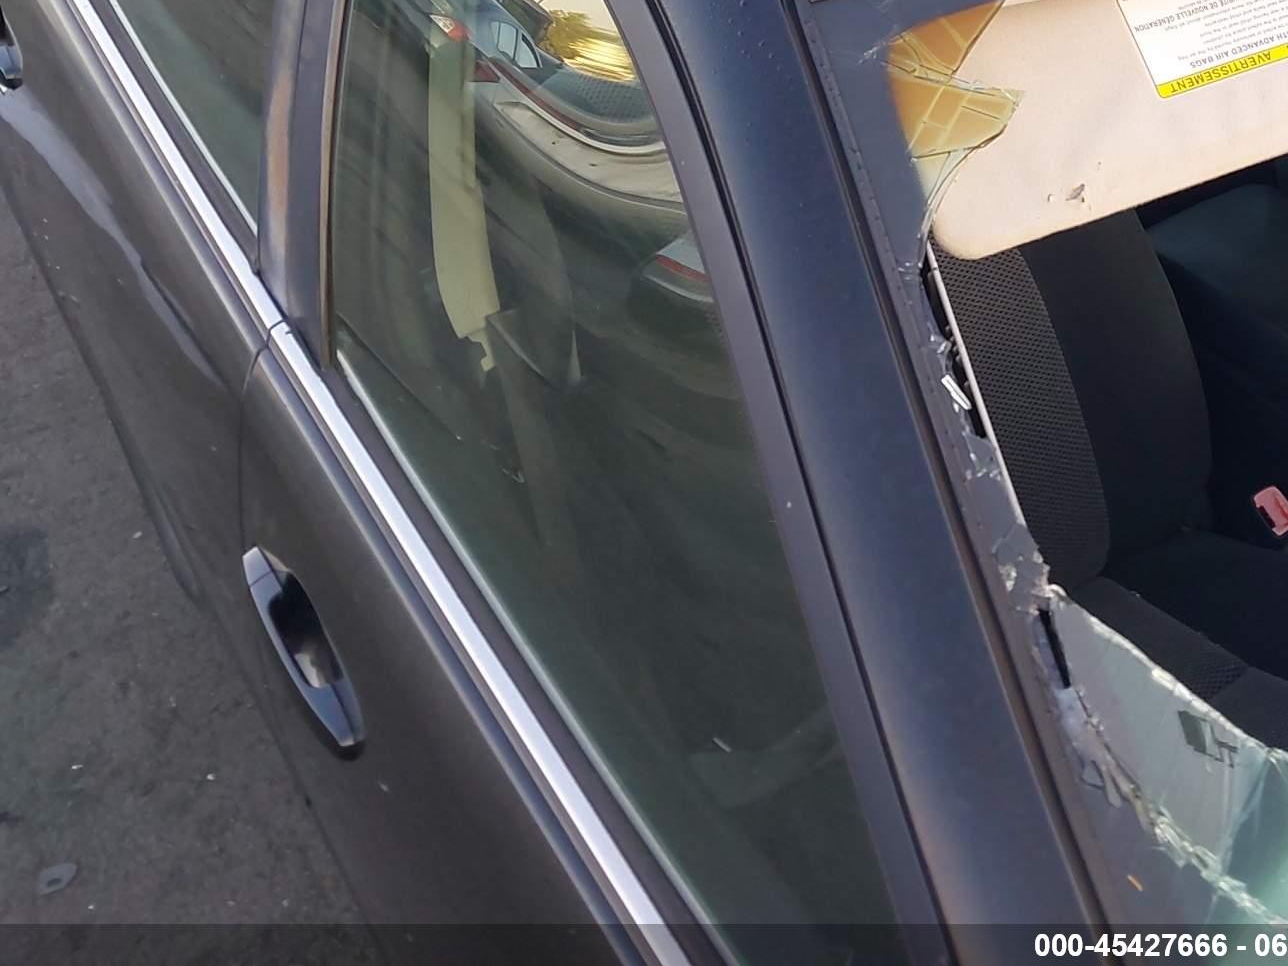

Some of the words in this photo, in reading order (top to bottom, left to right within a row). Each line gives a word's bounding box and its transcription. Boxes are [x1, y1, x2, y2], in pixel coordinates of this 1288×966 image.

[1208, 0, 1219, 9] DE
[1230, 35, 1276, 55] ADVANCED
[1188, 54, 1214, 68] BAGS
[1213, 49, 1230, 60] AIR
[1167, 50, 1274, 93] AVERTISSEMENT
